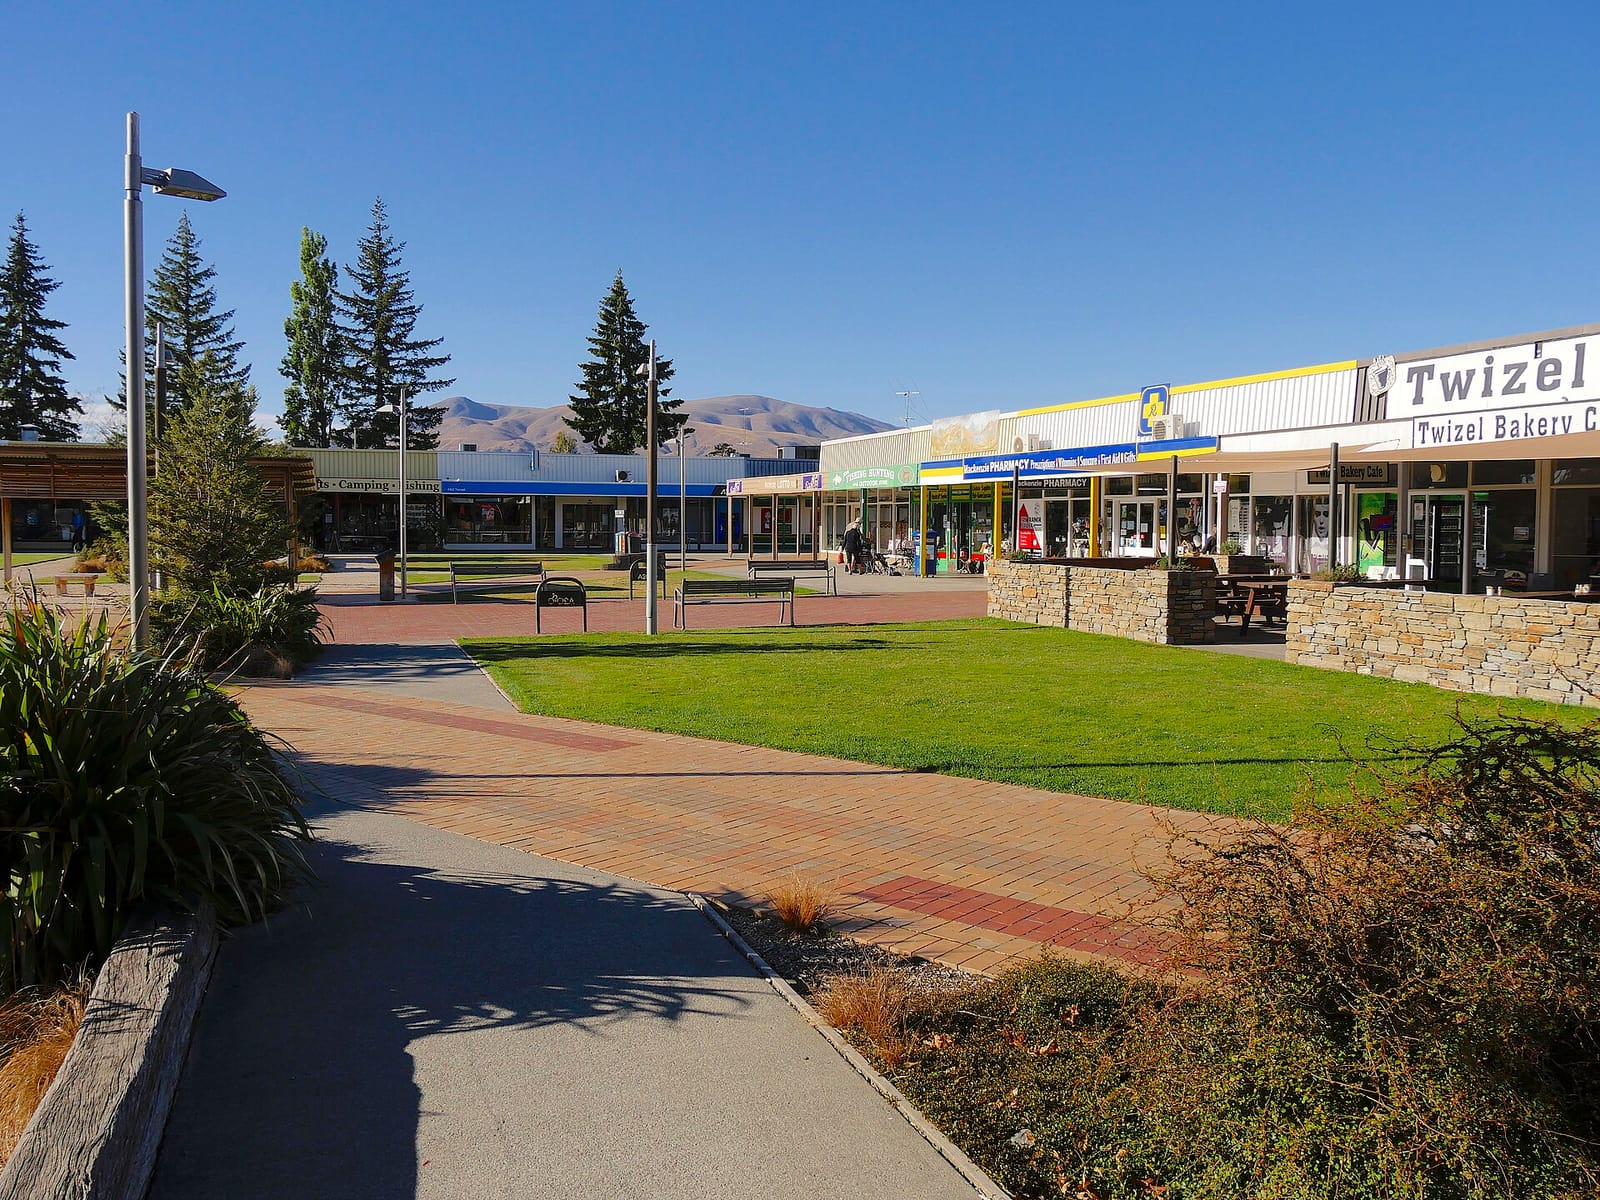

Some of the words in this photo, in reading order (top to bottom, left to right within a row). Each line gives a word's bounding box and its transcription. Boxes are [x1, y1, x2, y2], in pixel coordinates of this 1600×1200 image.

[1406, 342, 1586, 405] Twizel
[1418, 416, 1483, 444] Twizel
[1495, 412, 1573, 439] Bakery
[963, 463, 989, 474] Mackenzie
[990, 459, 1030, 473] PHARMACY
[1101, 453, 1112, 464] First
[1112, 452, 1121, 464] Aid
[1124, 451, 1137, 463] Gifts
[1340, 465, 1366, 480] Bakery
[1367, 465, 1384, 478] Cafe
[338, 479, 389, 492] Camping
[398, 480, 440, 492] ishing
[1017, 480, 1043, 488] ackenzie
[1043, 478, 1088, 488] PHARMACY
